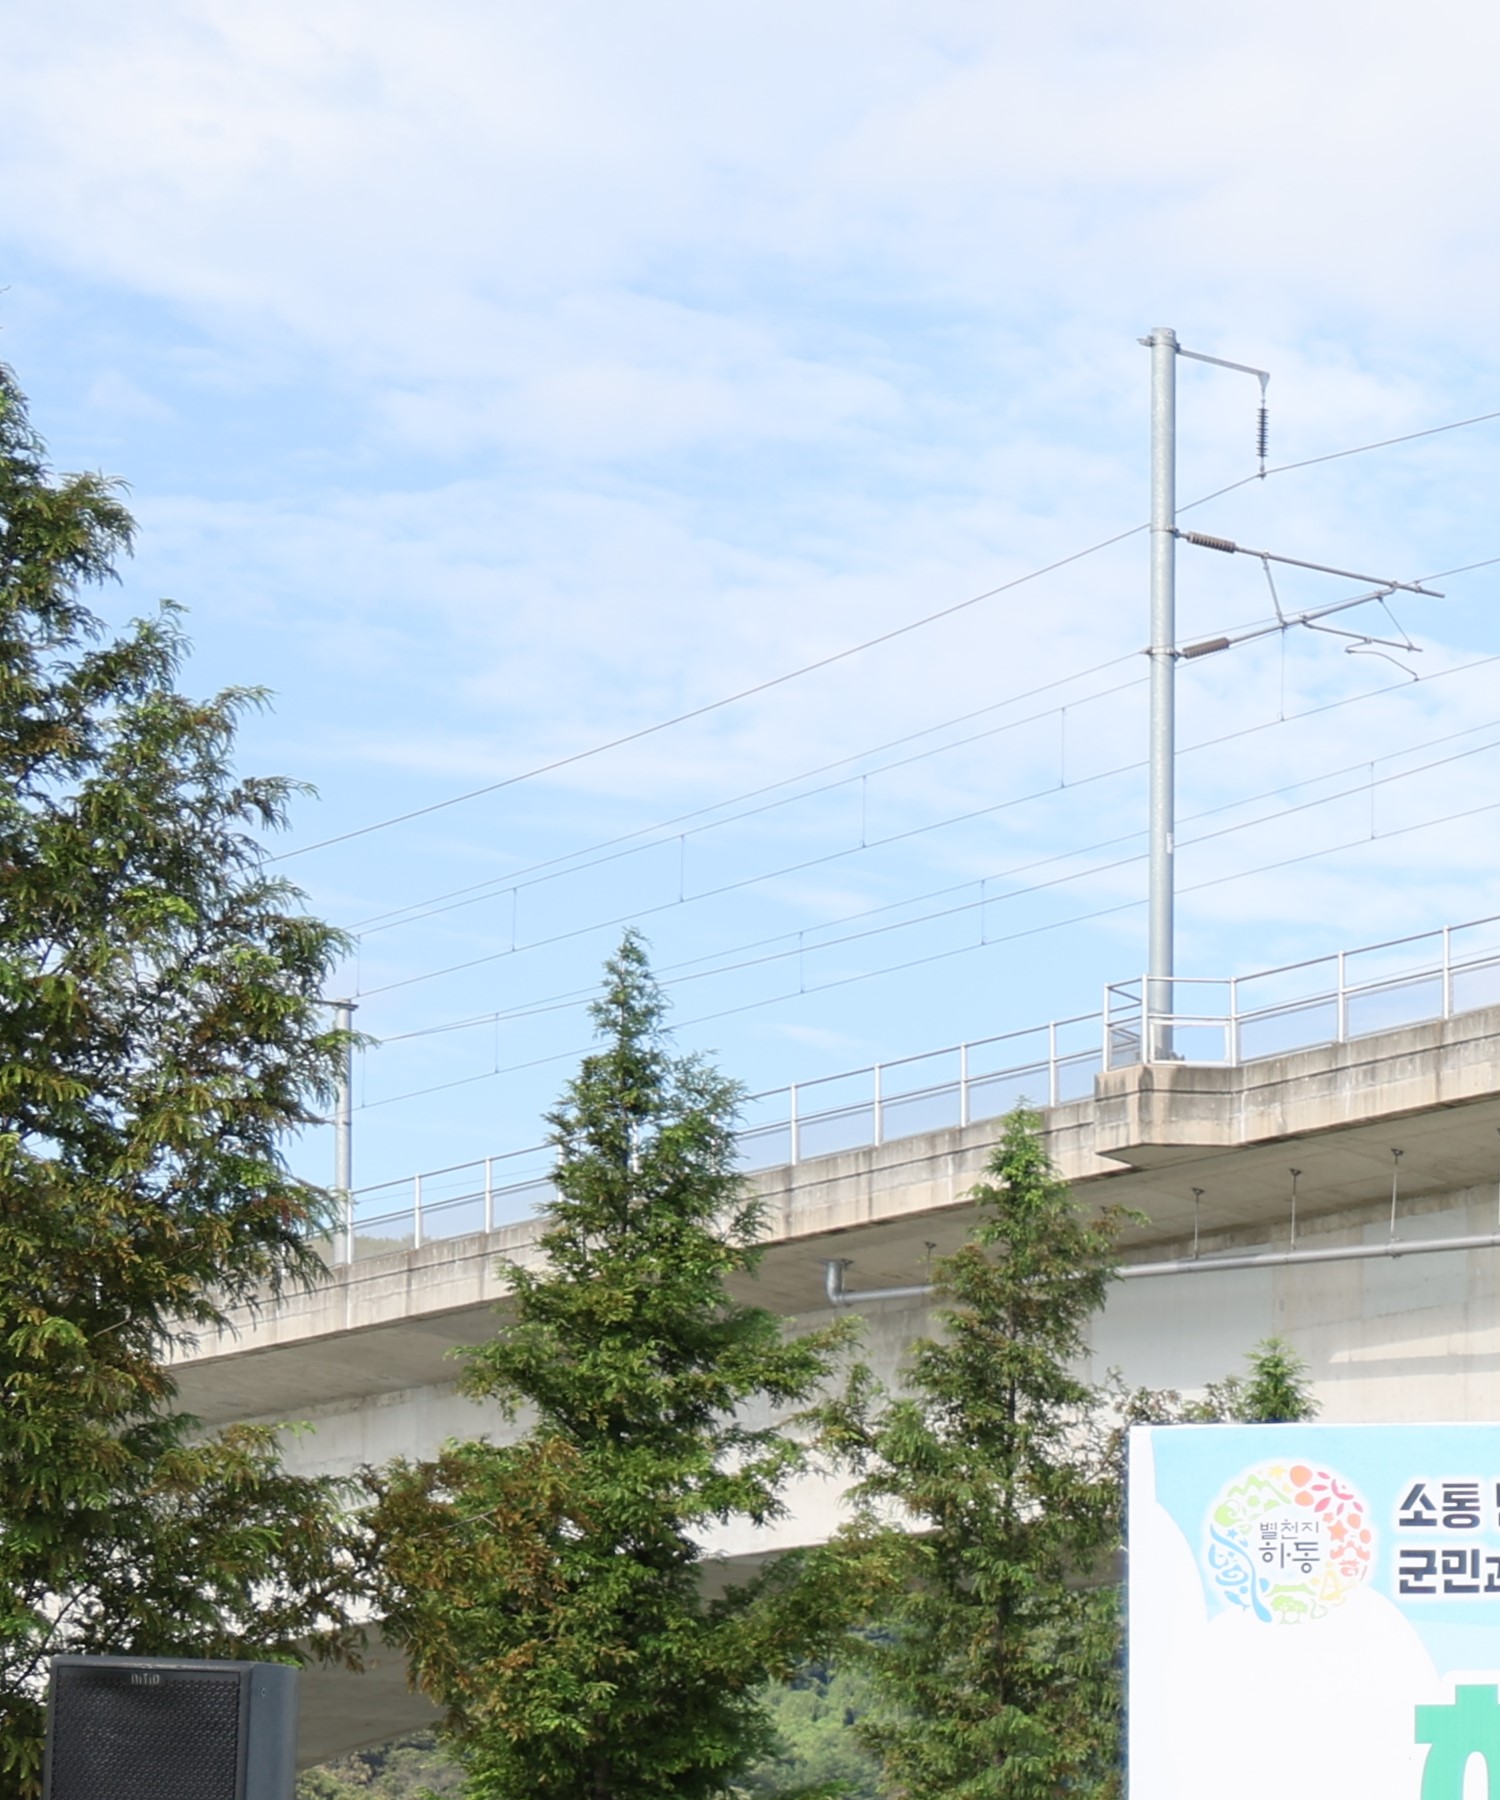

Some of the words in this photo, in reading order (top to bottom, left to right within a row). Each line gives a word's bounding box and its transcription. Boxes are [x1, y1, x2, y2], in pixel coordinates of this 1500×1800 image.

[1399, 1483, 1480, 1528] 소통
[1259, 1519, 1320, 1540] 별천지
[1258, 1540, 1321, 1574] 하동
